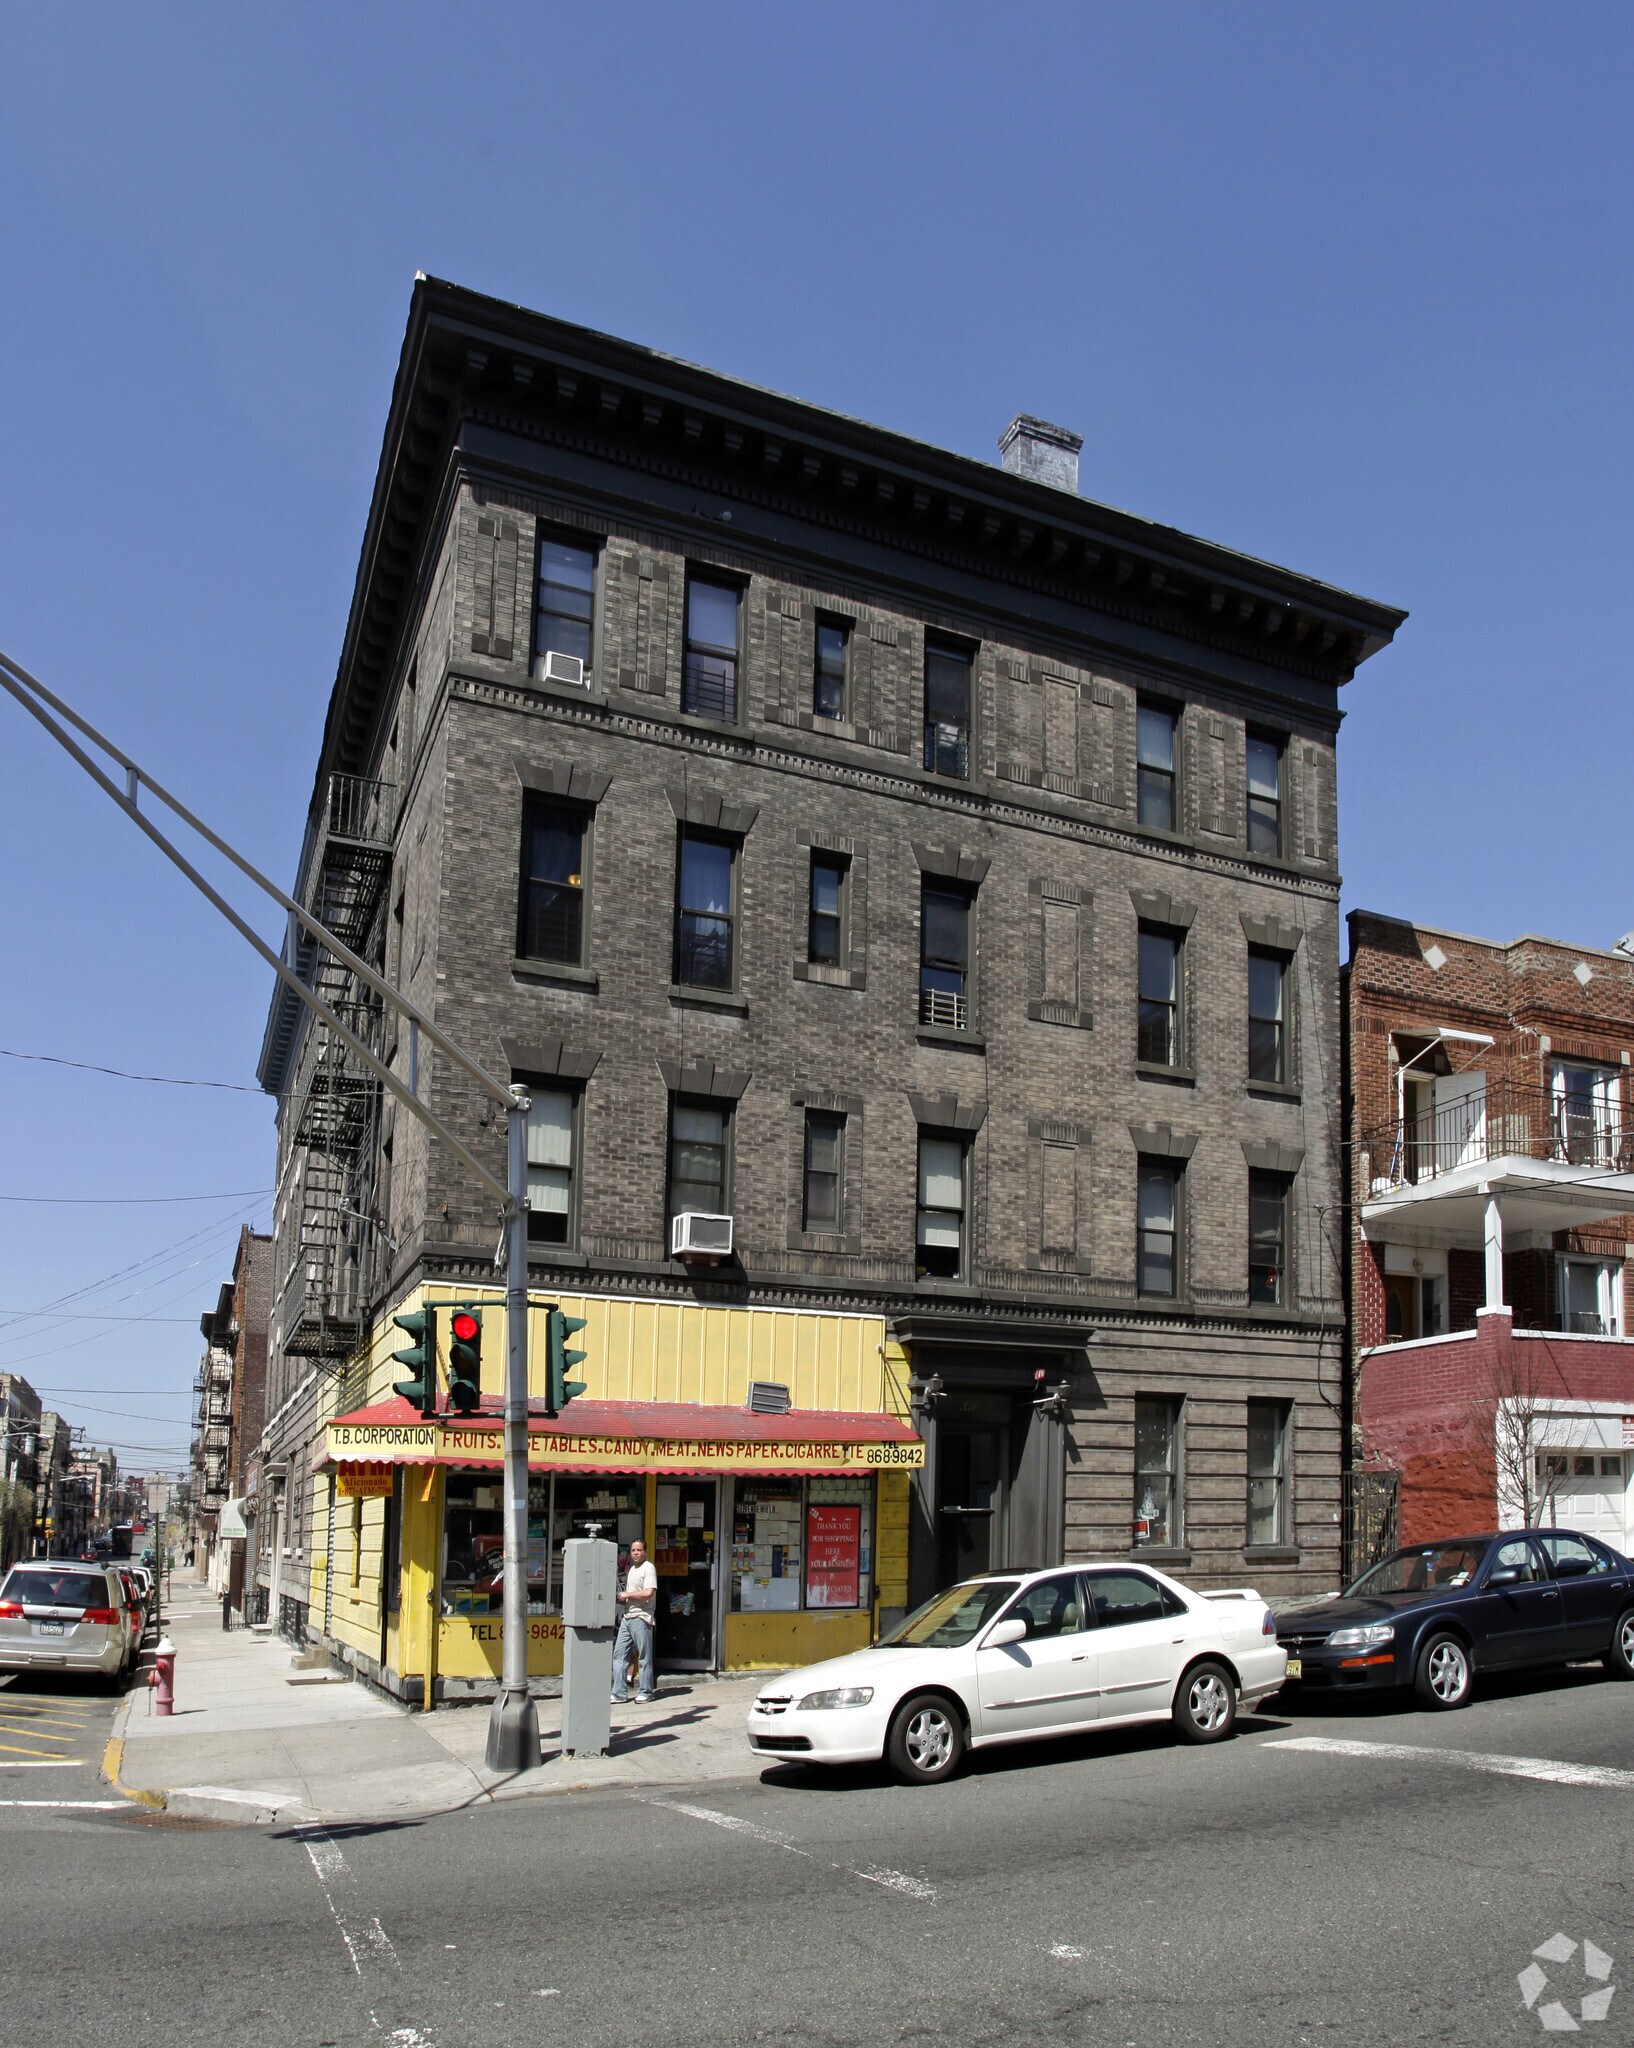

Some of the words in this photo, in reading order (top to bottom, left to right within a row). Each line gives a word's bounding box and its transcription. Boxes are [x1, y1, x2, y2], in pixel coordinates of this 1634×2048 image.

[356, 1428, 435, 1445] CORPORATION
[881, 1440, 899, 1449] TEL
[344, 1477, 388, 1487] Aficionado
[816, 1522, 837, 1530] THANK
[838, 1522, 851, 1530] YOU
[824, 1535, 854, 1543] SHOPPING
[825, 1547, 841, 1555] HERE
[469, 1624, 497, 1641] TEL
